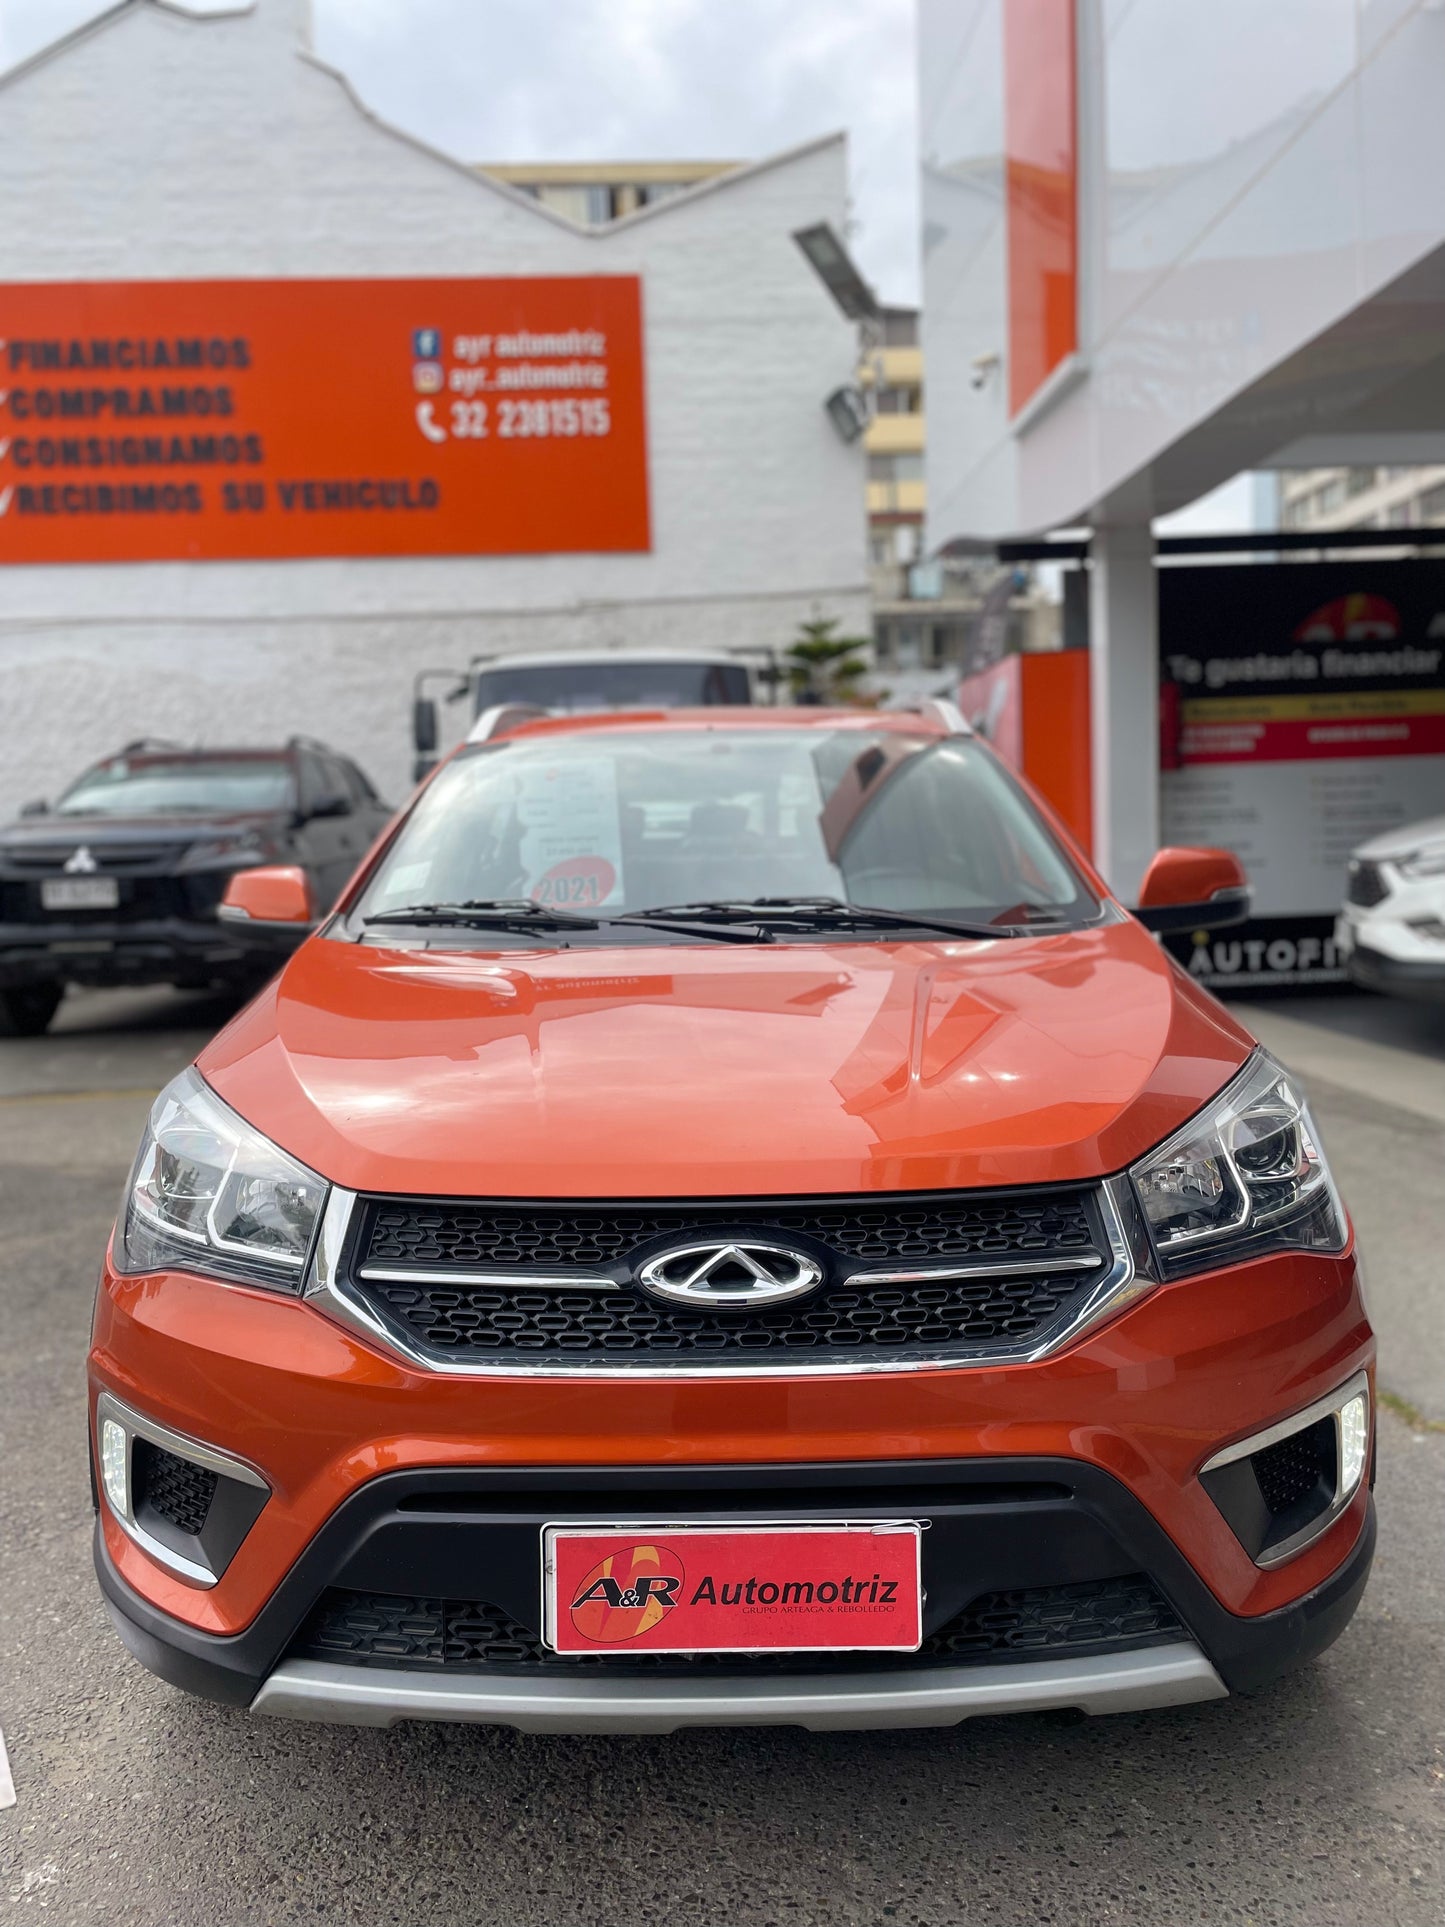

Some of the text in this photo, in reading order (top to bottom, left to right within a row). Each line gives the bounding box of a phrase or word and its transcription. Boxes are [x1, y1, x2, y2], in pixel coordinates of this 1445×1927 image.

[7, 337, 251, 371] FINANCIAMOS
[495, 330, 605, 358] automotriz
[8, 386, 234, 420] COMPRAMOS
[451, 400, 488, 438] 32
[10, 434, 263, 468] CONSIGNAMOS
[15, 478, 440, 515] RECIBIMOS SU VEHICULO
[1168, 655, 1202, 684] Te
[1321, 645, 1441, 678] financiar
[539, 875, 599, 904] 2021
[1188, 937, 1340, 975] AUTOFI
[569, 1573, 898, 1609] A&R Automotriz
[742, 1606, 778, 1614] GRUPO
[781, 1605, 824, 1613] ARTEAGA
[837, 1605, 895, 1613] REBOLLEDO
